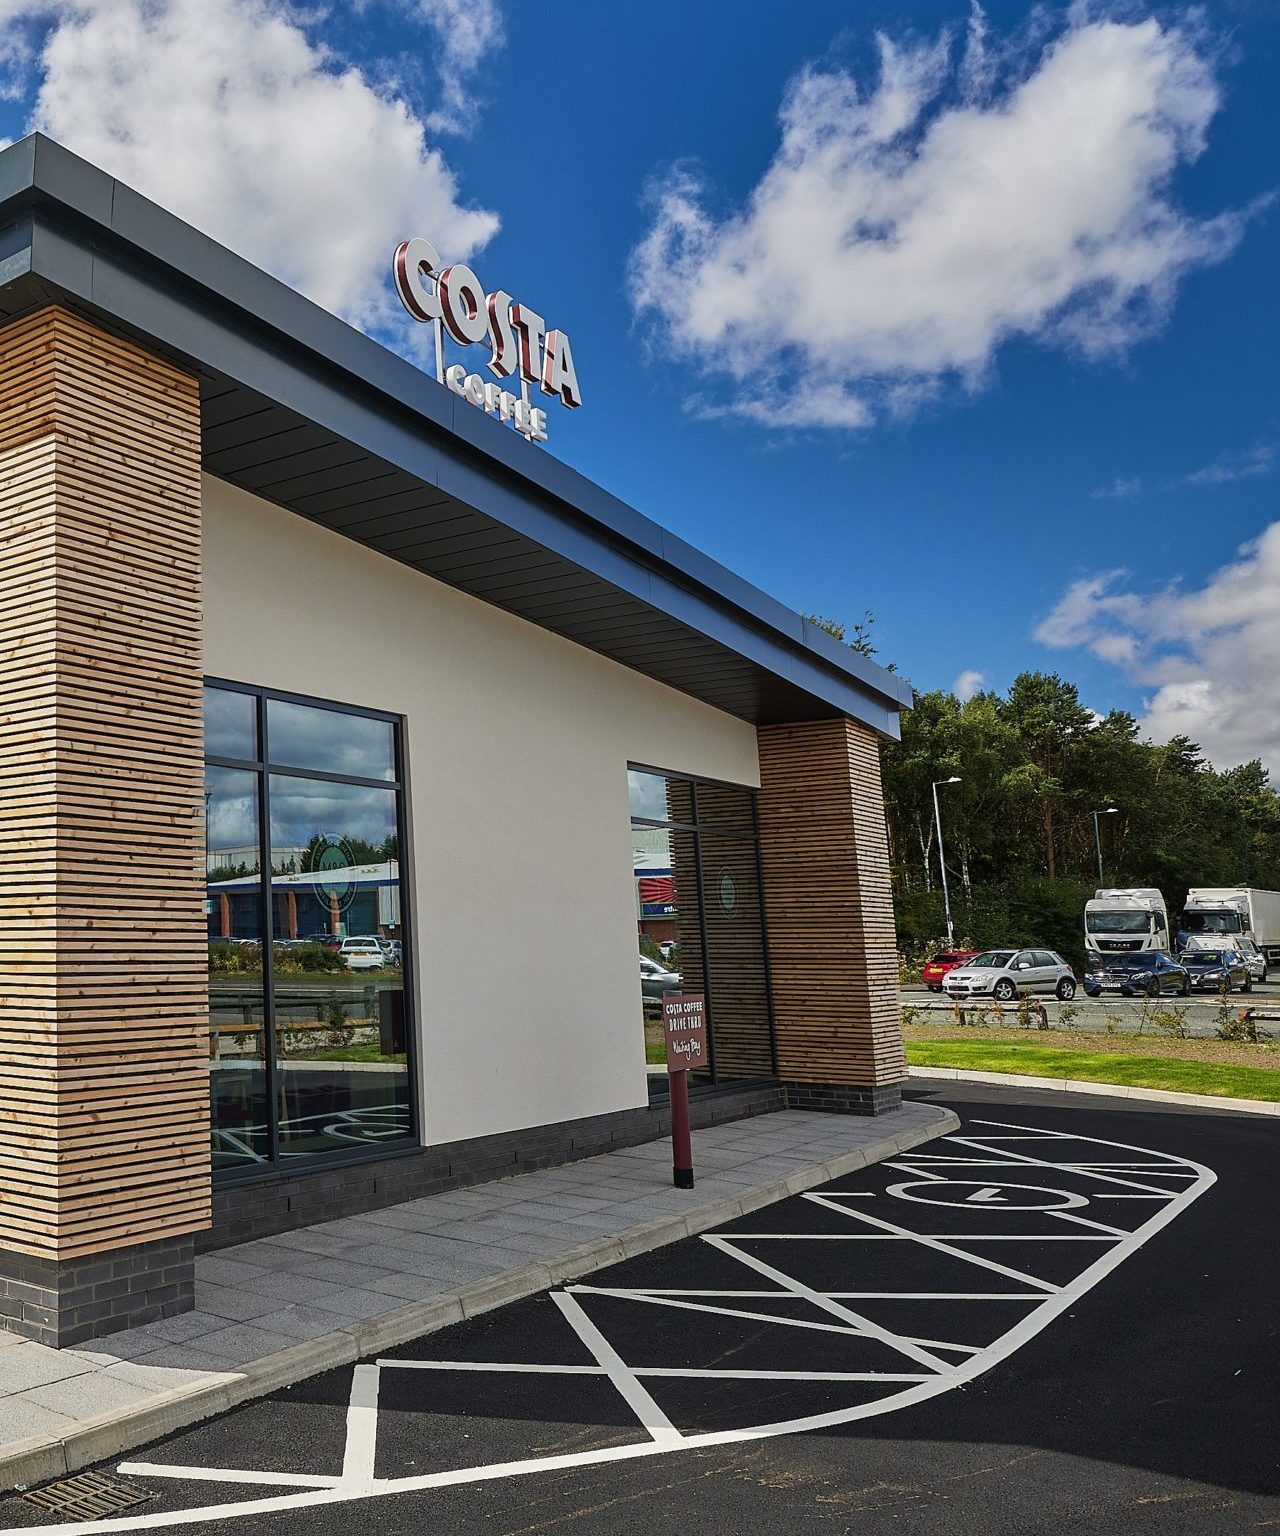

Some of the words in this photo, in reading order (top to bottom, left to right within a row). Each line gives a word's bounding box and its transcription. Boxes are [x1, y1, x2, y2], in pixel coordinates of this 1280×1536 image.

[393, 238, 583, 408] COSTA
[446, 364, 549, 441] COFFEE
[666, 1003, 683, 1015] COSTA
[683, 1001, 703, 1013] COFFEE
[669, 1018, 686, 1031] DRIVE
[687, 1015, 702, 1029] THRU
